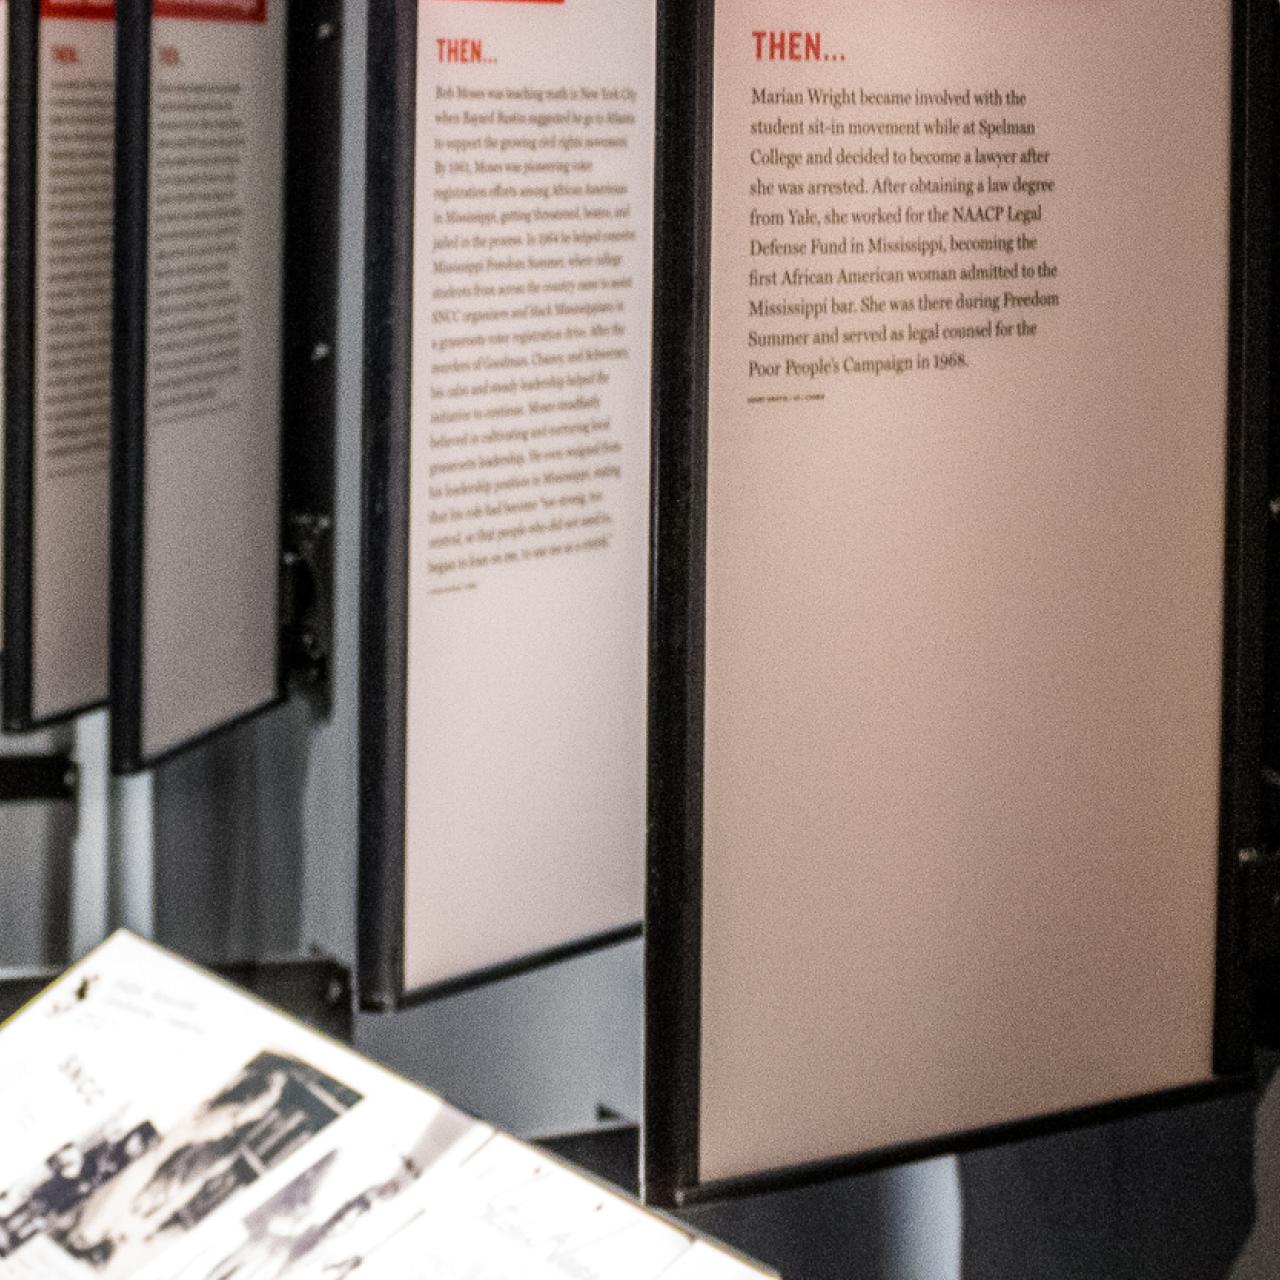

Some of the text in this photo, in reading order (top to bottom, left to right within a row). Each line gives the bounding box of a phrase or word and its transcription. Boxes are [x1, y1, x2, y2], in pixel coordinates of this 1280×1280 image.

[436, 38, 497, 64] THEN...
[752, 32, 845, 61] THEN...
[752, 87, 1026, 109] Marian Wright became involved with the
[750, 147, 1050, 169] College and decided to become a lawyer after
